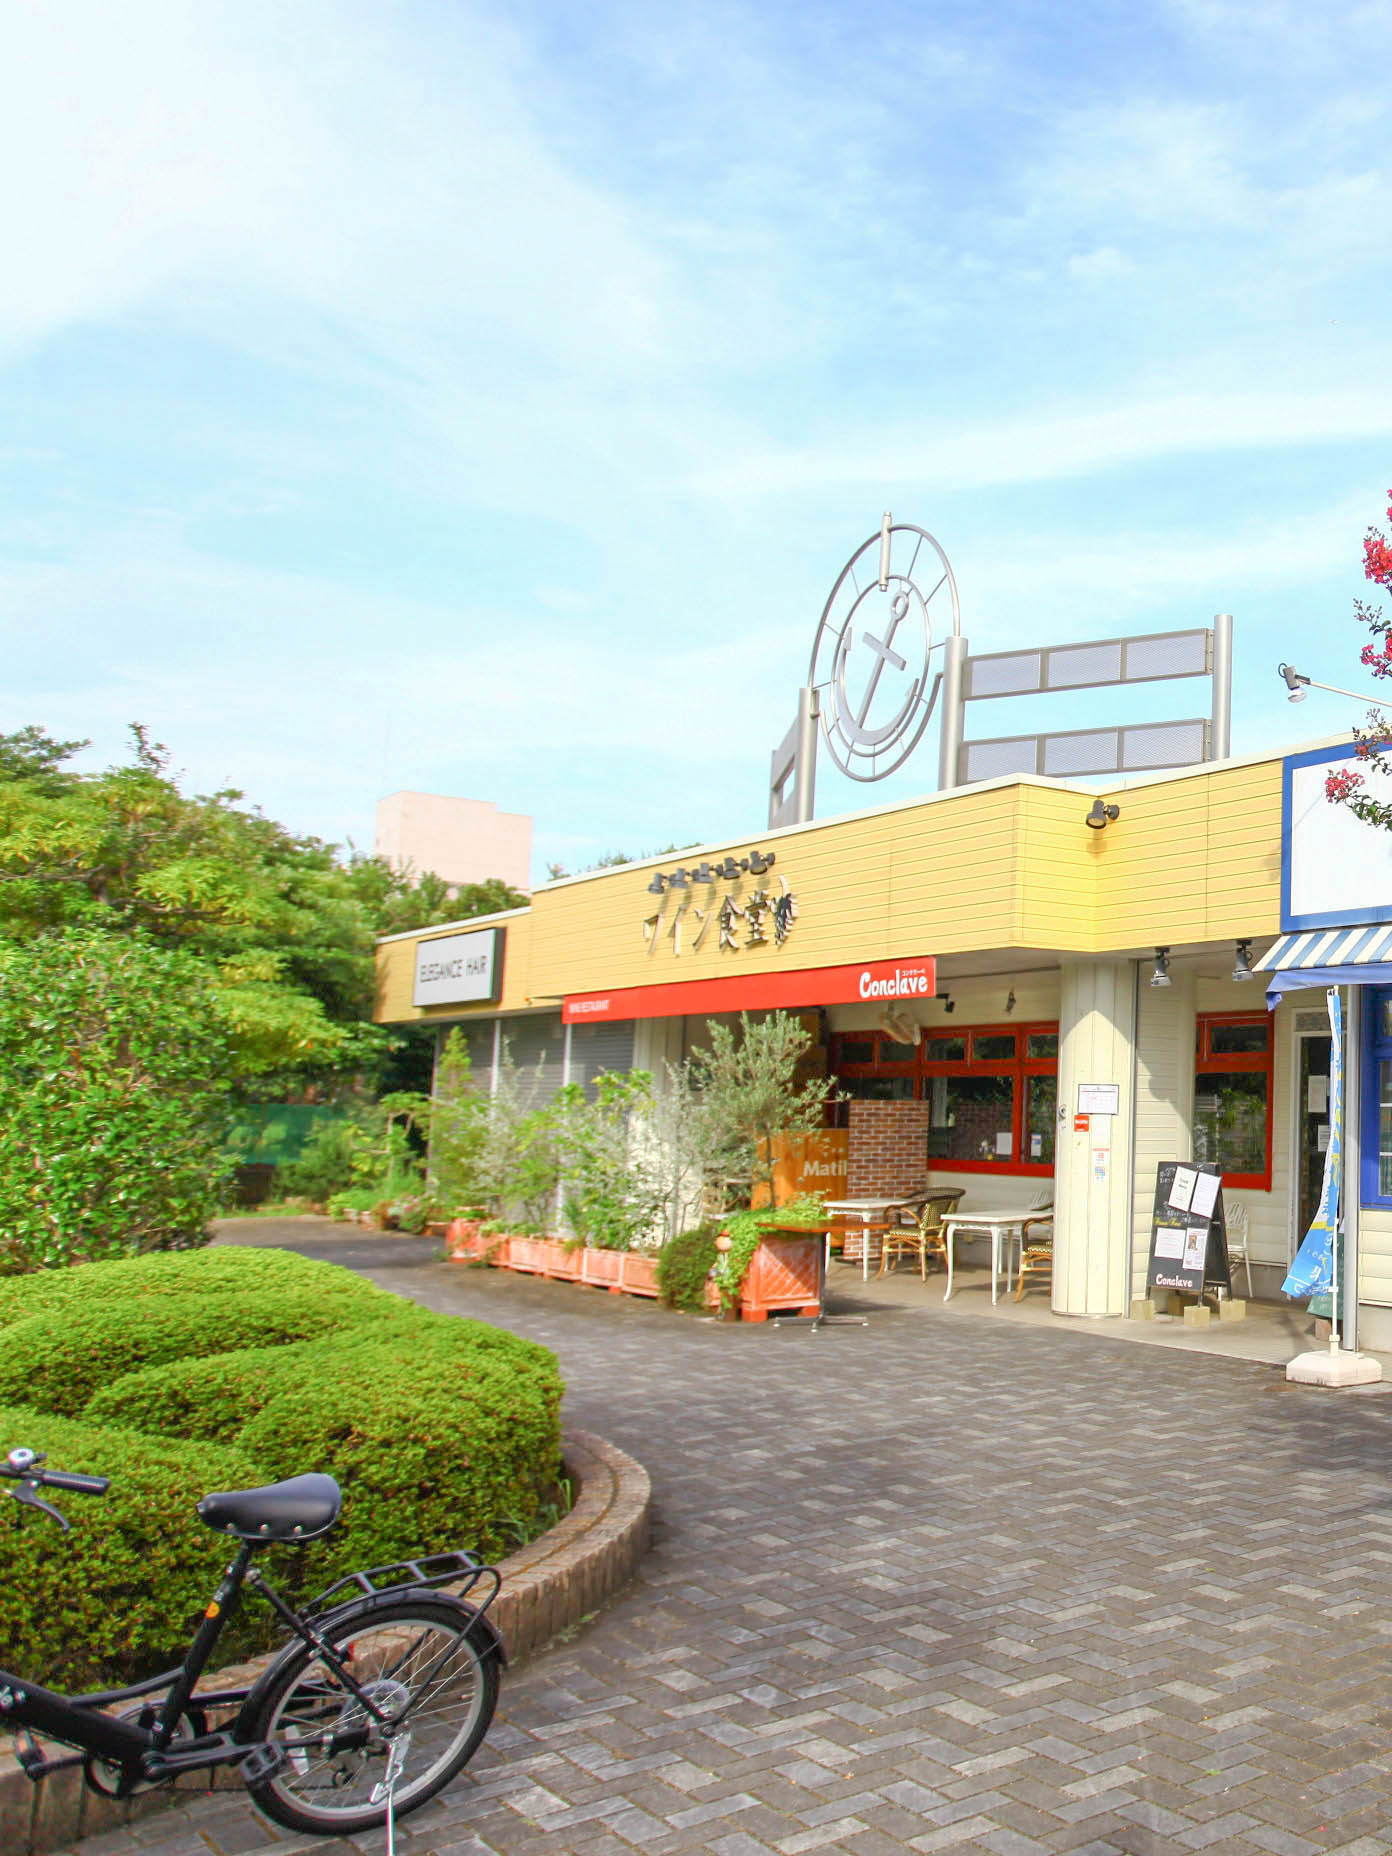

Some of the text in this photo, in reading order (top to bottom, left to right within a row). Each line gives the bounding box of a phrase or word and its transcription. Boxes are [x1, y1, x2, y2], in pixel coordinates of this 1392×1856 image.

[643, 889, 770, 957] ワイン食堂
[420, 955, 488, 983] ELEGANCE HAIR
[859, 969, 928, 999] Conclave
[1155, 1273, 1193, 1288] Conclave
